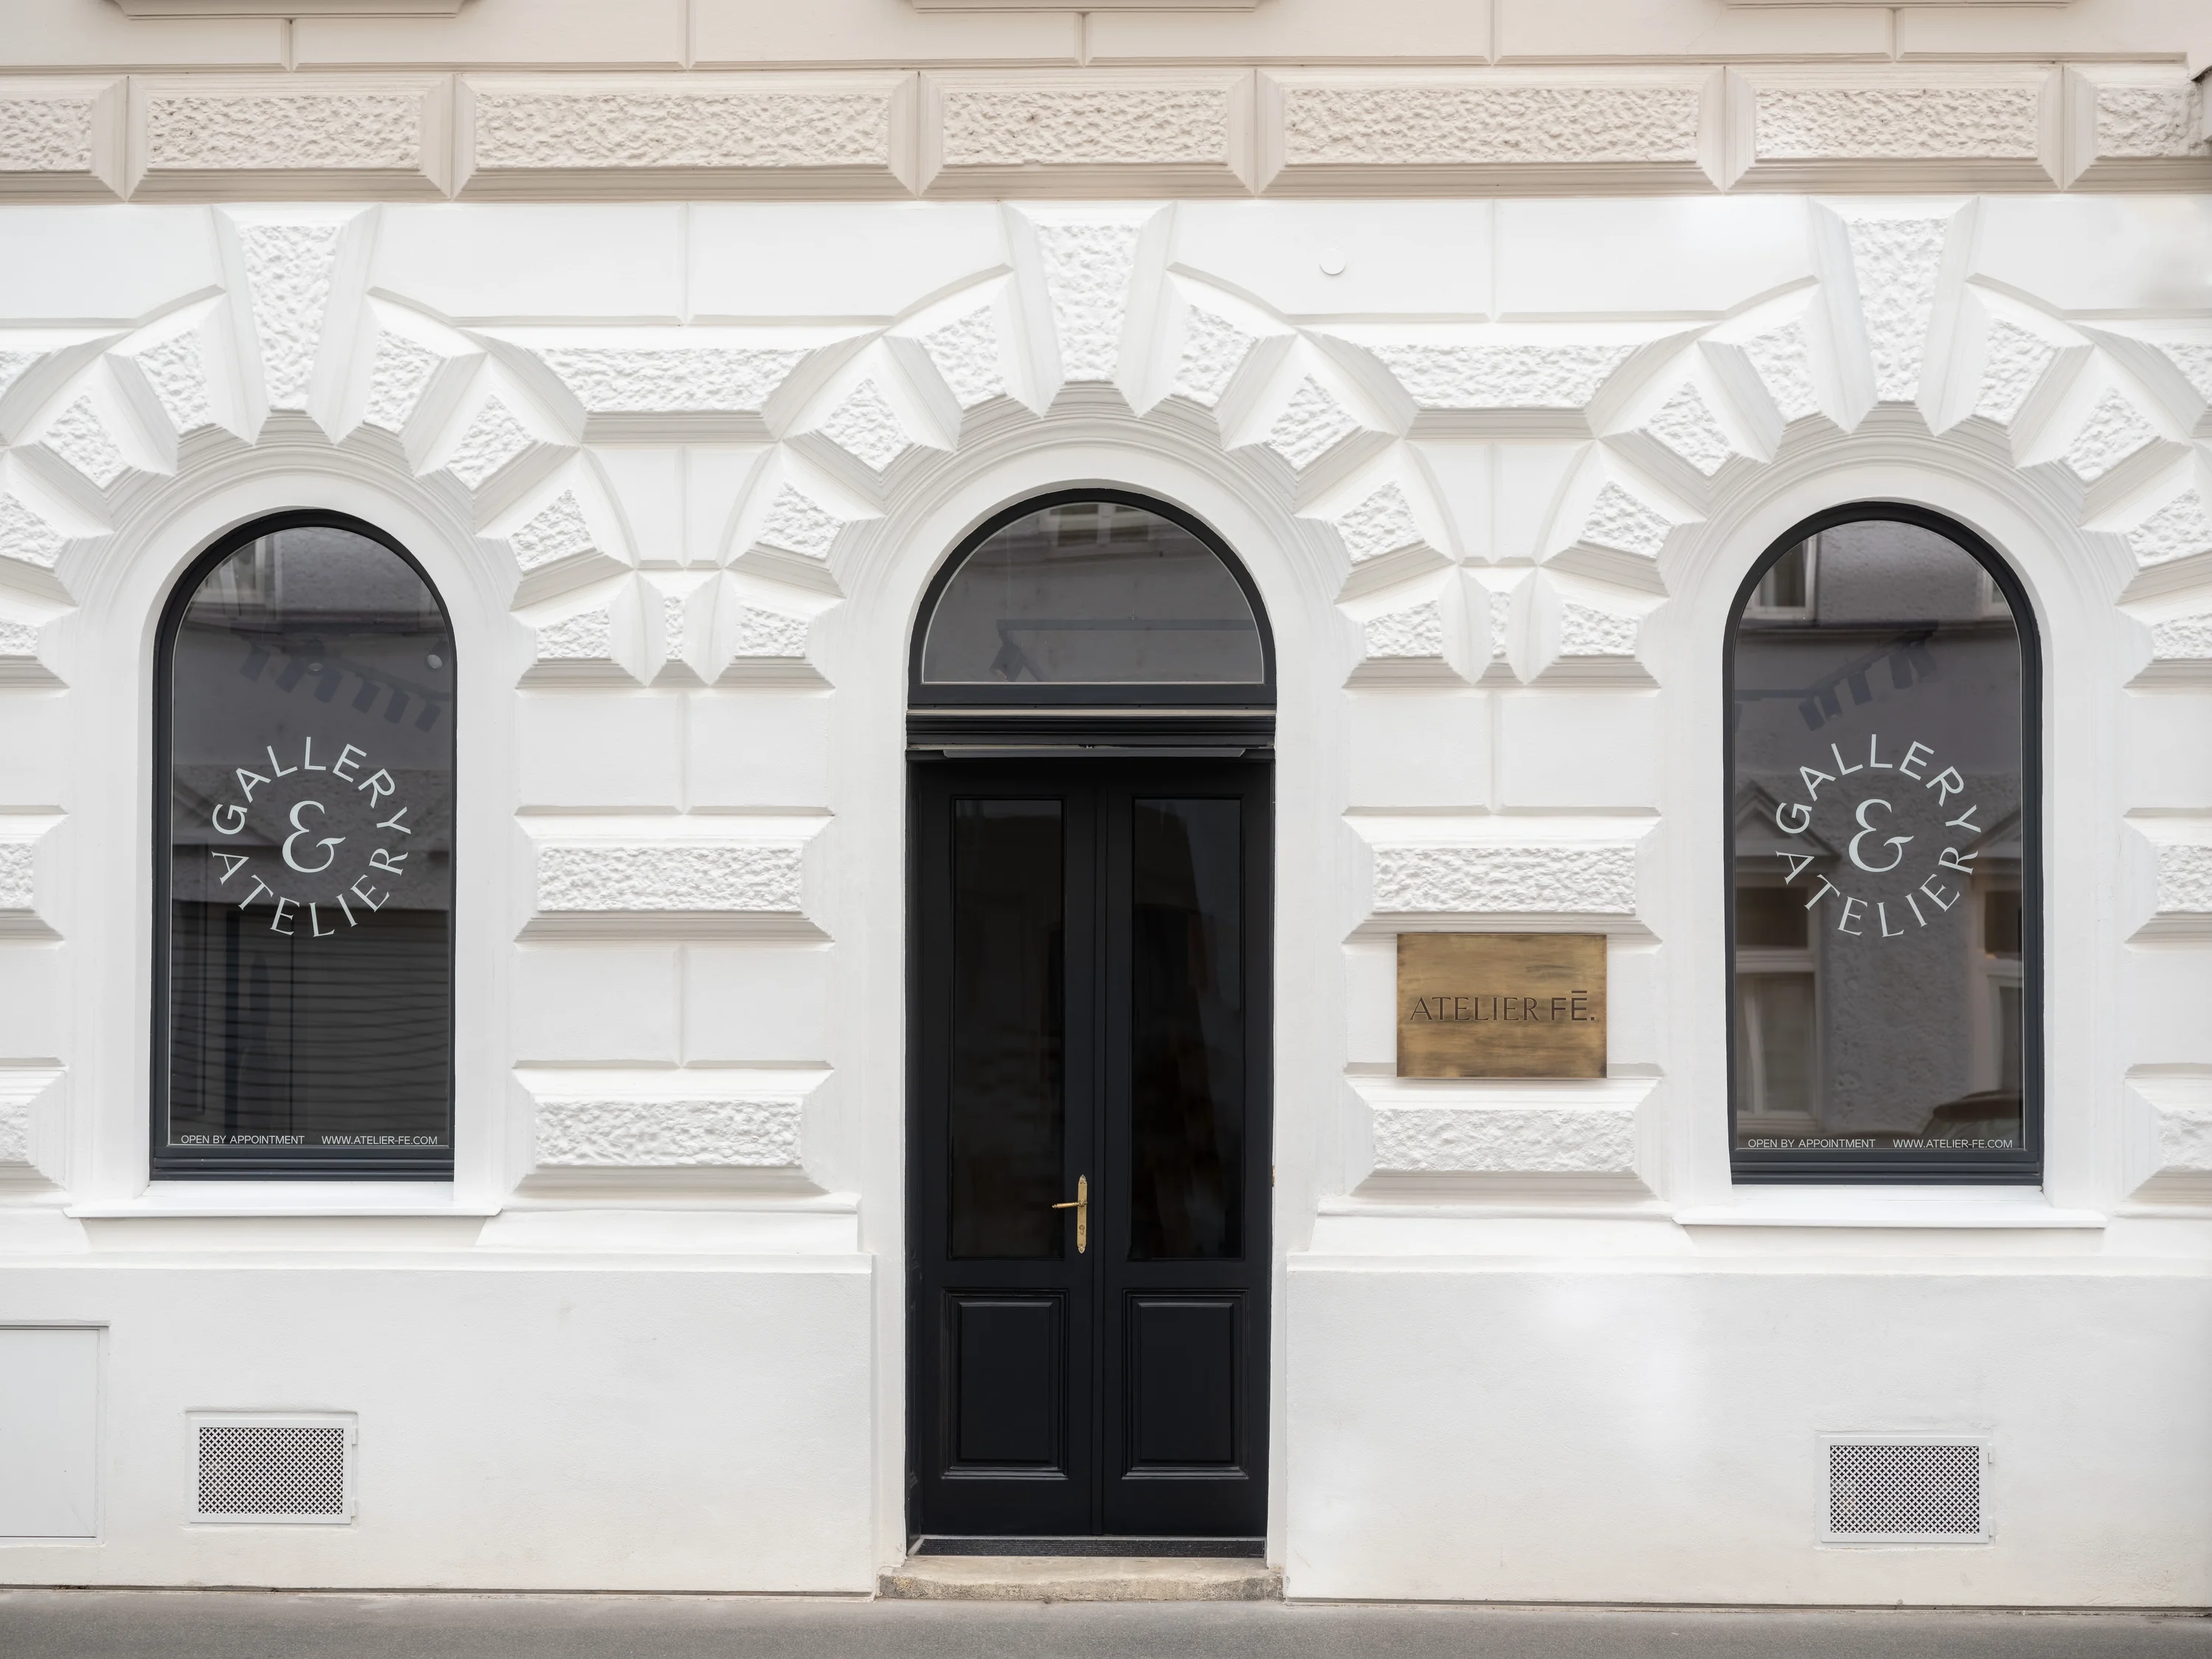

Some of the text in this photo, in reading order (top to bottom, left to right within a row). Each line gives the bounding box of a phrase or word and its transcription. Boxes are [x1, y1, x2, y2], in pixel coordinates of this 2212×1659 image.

[212, 736, 411, 835] GALLERY
[1775, 734, 1982, 834] GALLERY
[282, 800, 347, 874] &
[1848, 799, 1915, 873] &
[211, 848, 408, 938] ATELIER
[1775, 846, 1979, 939] ATELIER
[1409, 996, 1540, 1021] ATELIER
[181, 1135, 438, 1145] OPEN BY APPOINTMENT WWW.ATELIER-FE.COM
[1747, 1138, 2013, 1149] OPEN BY APPOINTMENT WWW.ATELIER-FE.COM
